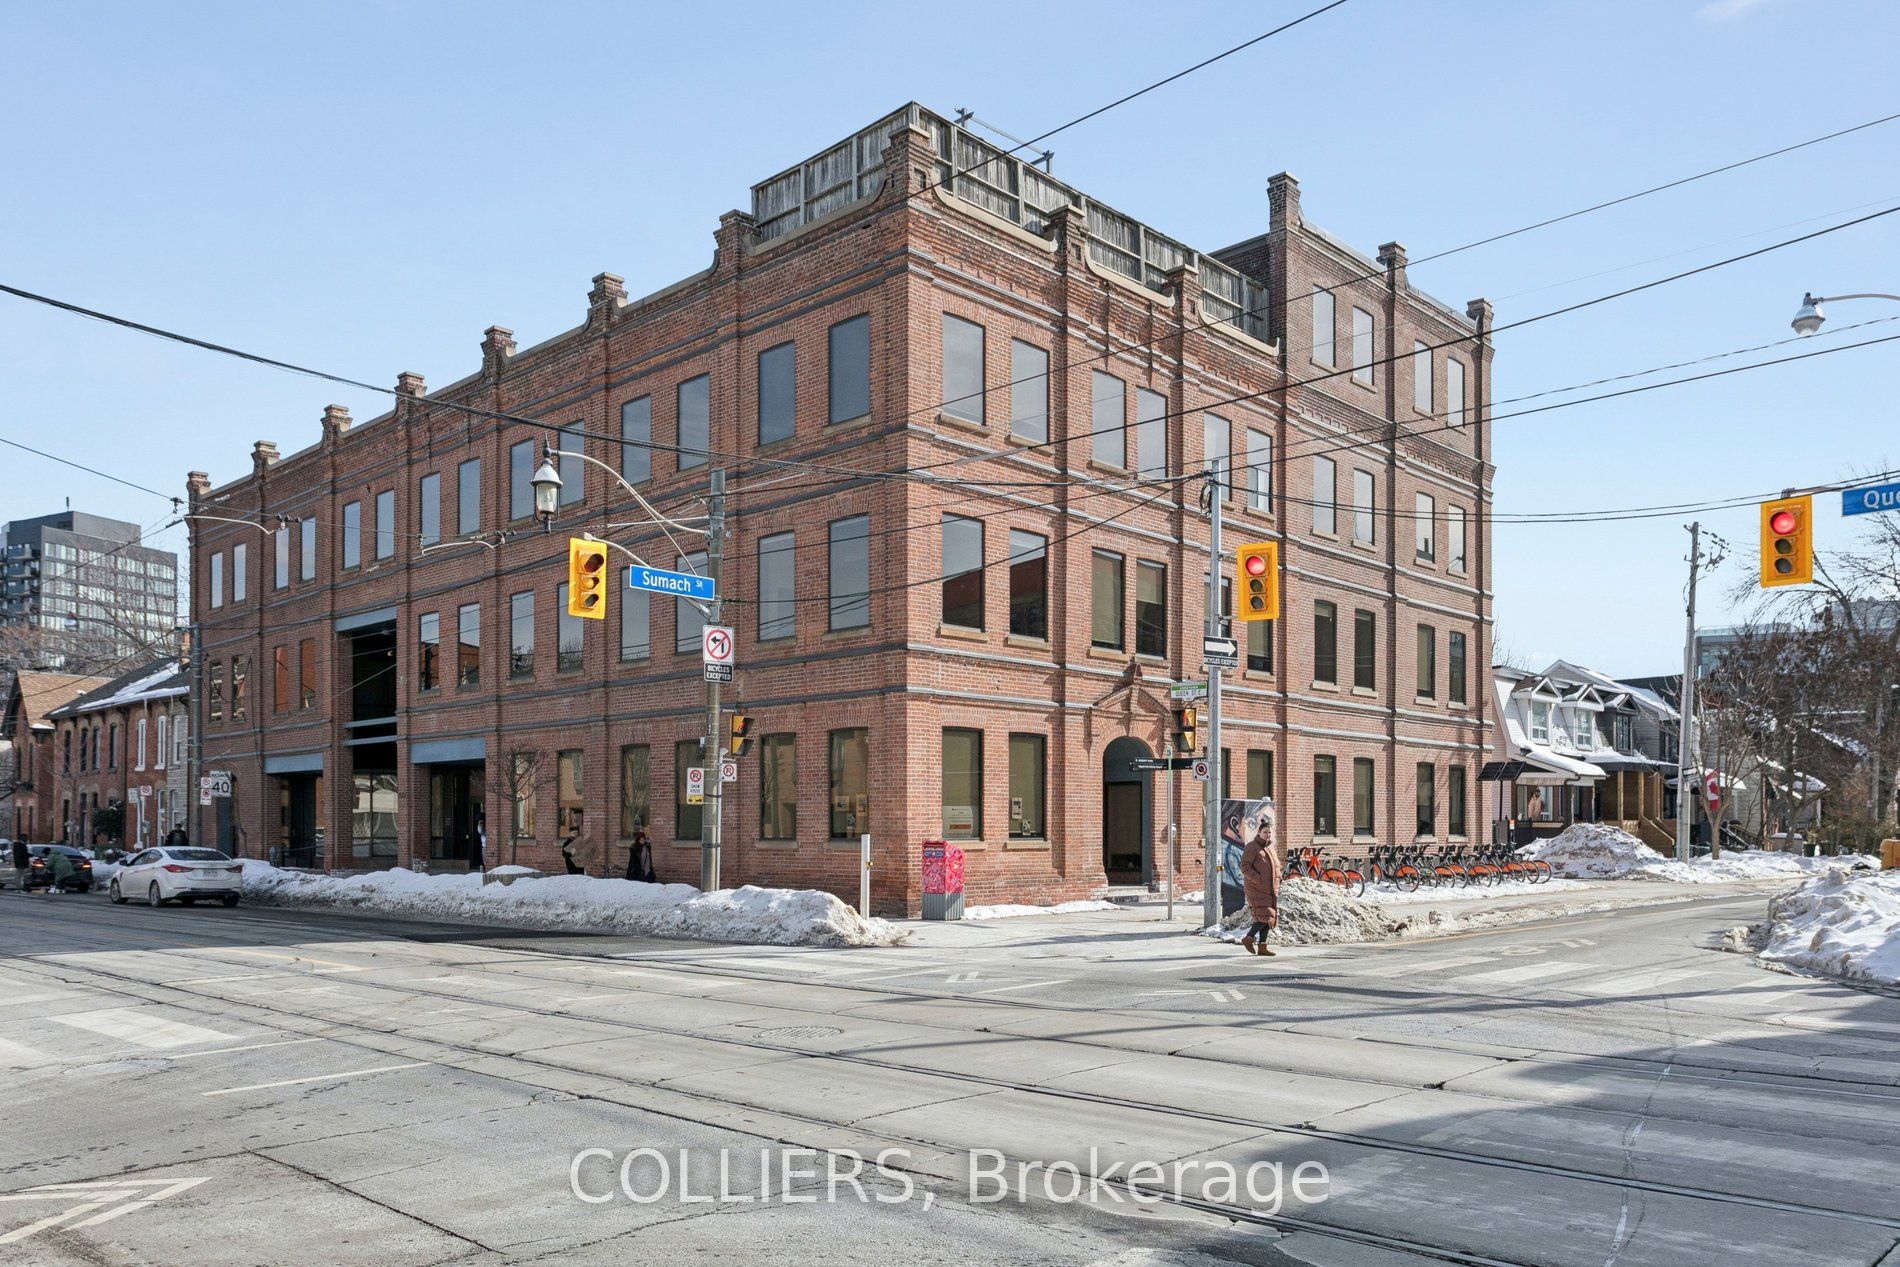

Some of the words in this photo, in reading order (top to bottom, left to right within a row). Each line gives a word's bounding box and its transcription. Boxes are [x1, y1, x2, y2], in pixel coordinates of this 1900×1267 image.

[642, 571, 691, 592] Sumach
[707, 665, 730, 673] BICYCLES
[706, 671, 731, 680] EXCEPTED
[212, 781, 229, 793] 40
